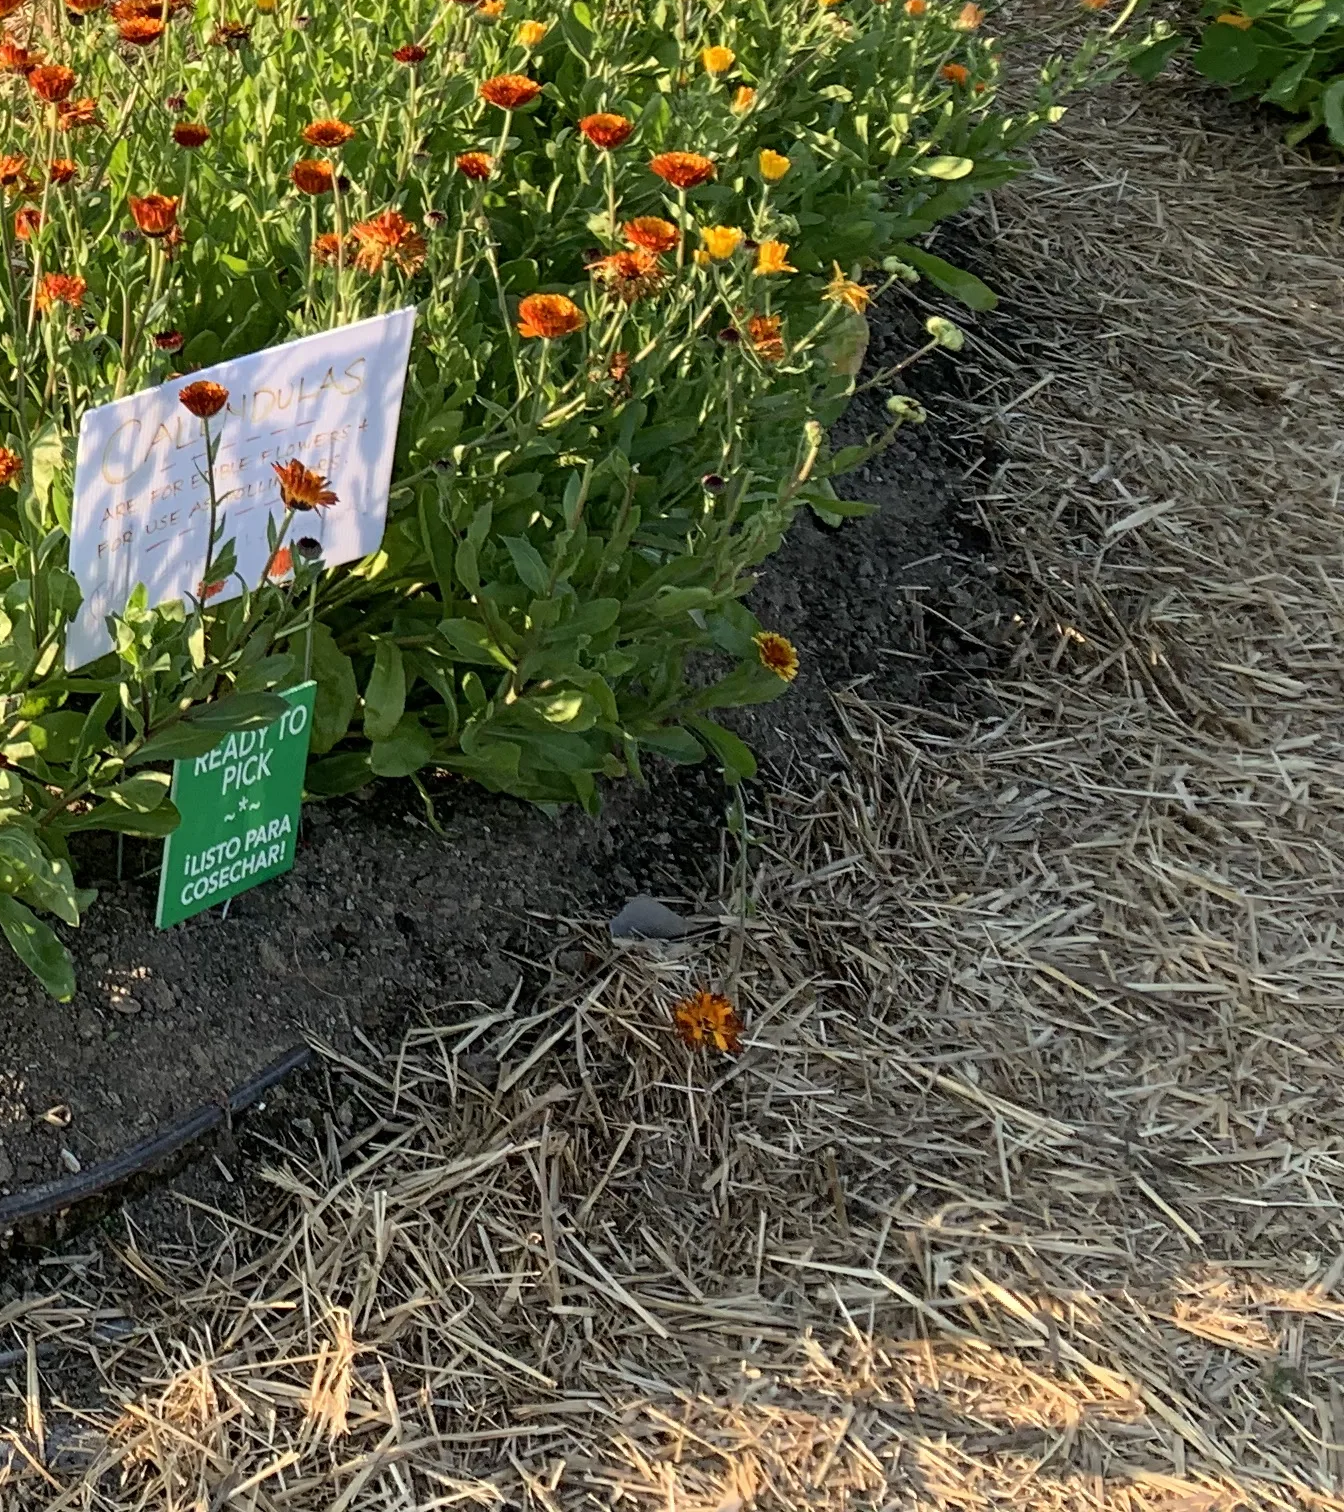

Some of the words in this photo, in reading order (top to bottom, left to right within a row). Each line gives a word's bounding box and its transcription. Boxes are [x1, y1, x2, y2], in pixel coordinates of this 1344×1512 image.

[151, 479, 184, 506] FOR
[97, 530, 133, 559] FOR
[145, 508, 183, 535] USE
[279, 704, 308, 741] TO
[222, 748, 274, 796] PICK
[184, 836, 241, 876] ¡LISTO
[244, 814, 292, 853] PARA
[180, 840, 287, 906] COSECHAR!
